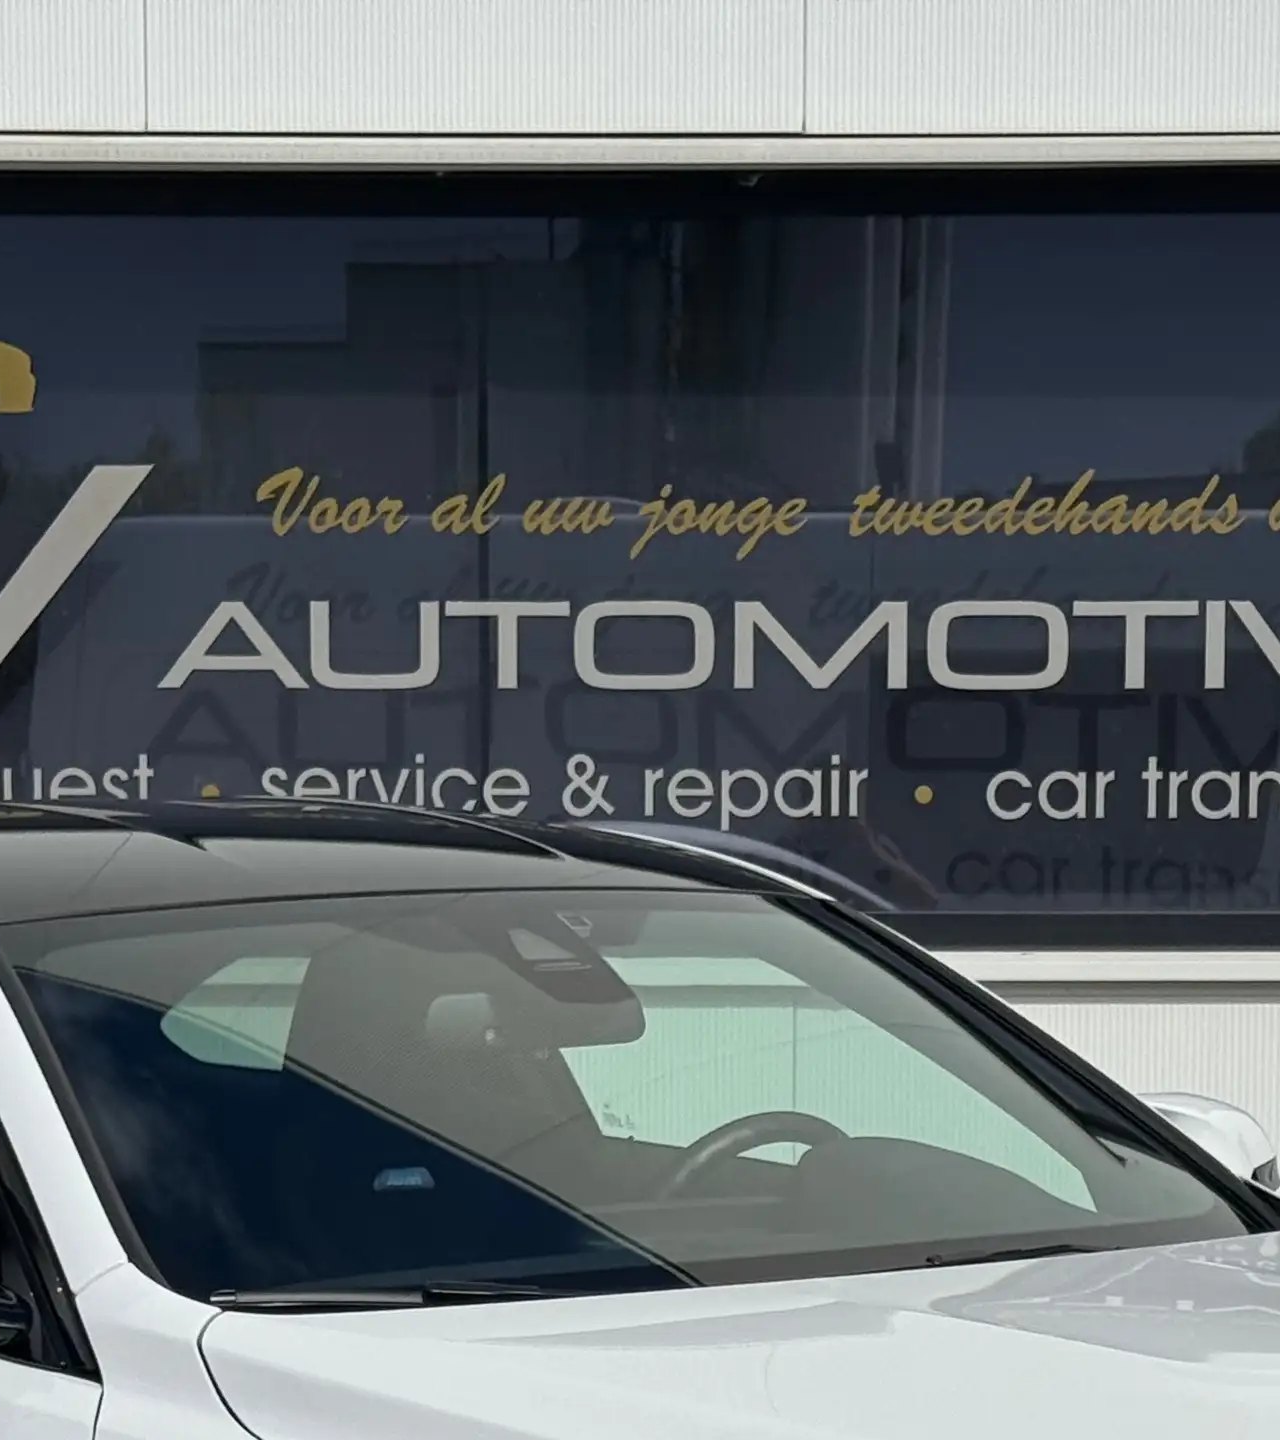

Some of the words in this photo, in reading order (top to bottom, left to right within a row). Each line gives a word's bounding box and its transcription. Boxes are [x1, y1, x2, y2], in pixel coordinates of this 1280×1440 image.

[257, 466, 410, 537] Voor
[432, 473, 508, 536] al
[522, 496, 617, 536] uw
[629, 483, 809, 562] jonge
[849, 468, 1244, 538] tweedehands
[561, 753, 615, 817] &
[644, 754, 868, 831] repair
[986, 769, 1116, 820] car
